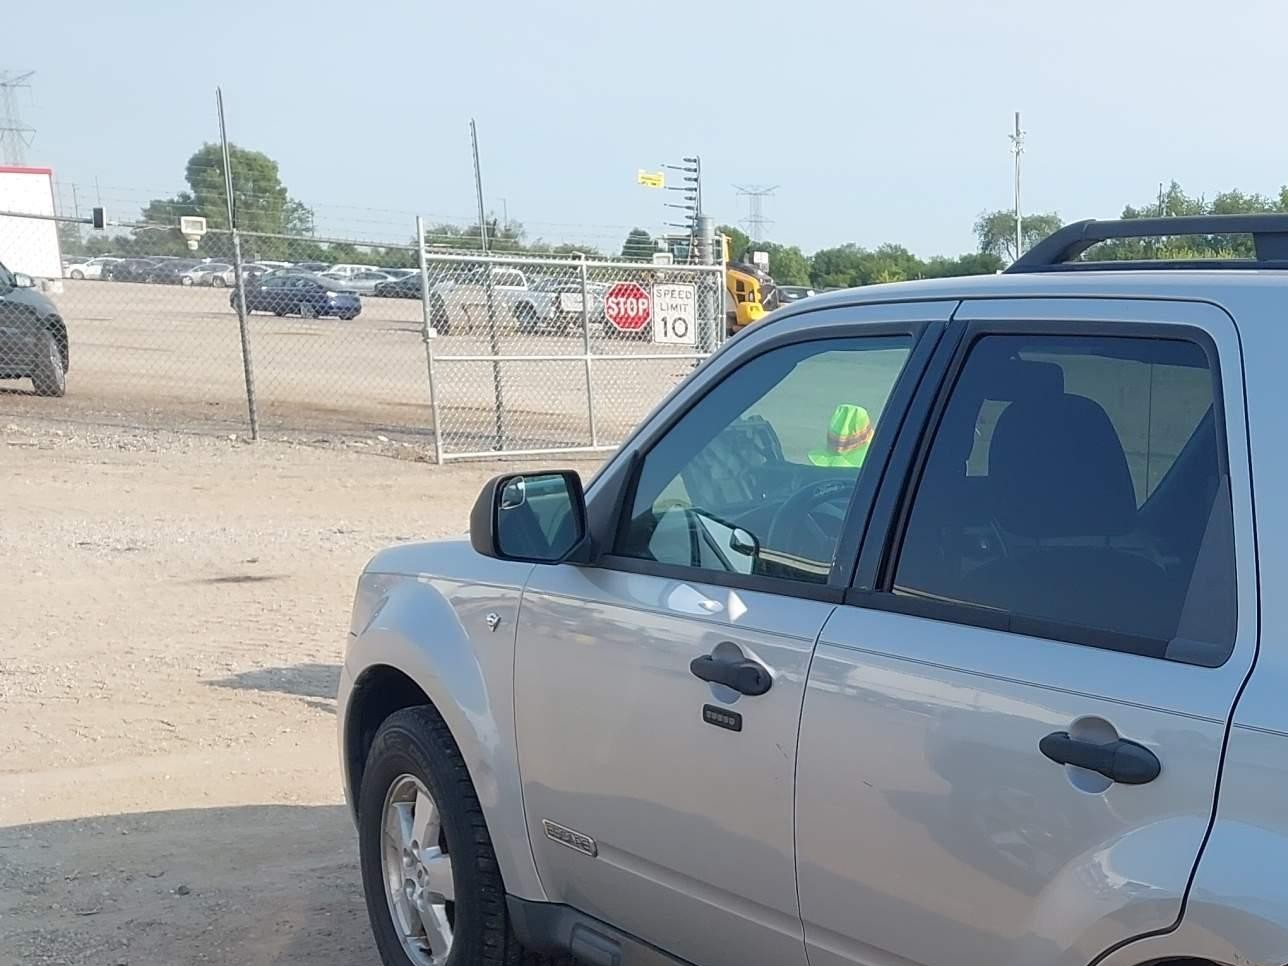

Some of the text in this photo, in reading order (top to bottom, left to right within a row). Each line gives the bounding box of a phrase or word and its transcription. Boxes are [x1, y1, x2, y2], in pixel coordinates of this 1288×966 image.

[656, 288, 692, 300] SPEED
[607, 298, 650, 317] STOP
[659, 302, 689, 313] LIMIT
[661, 316, 688, 338] 10
